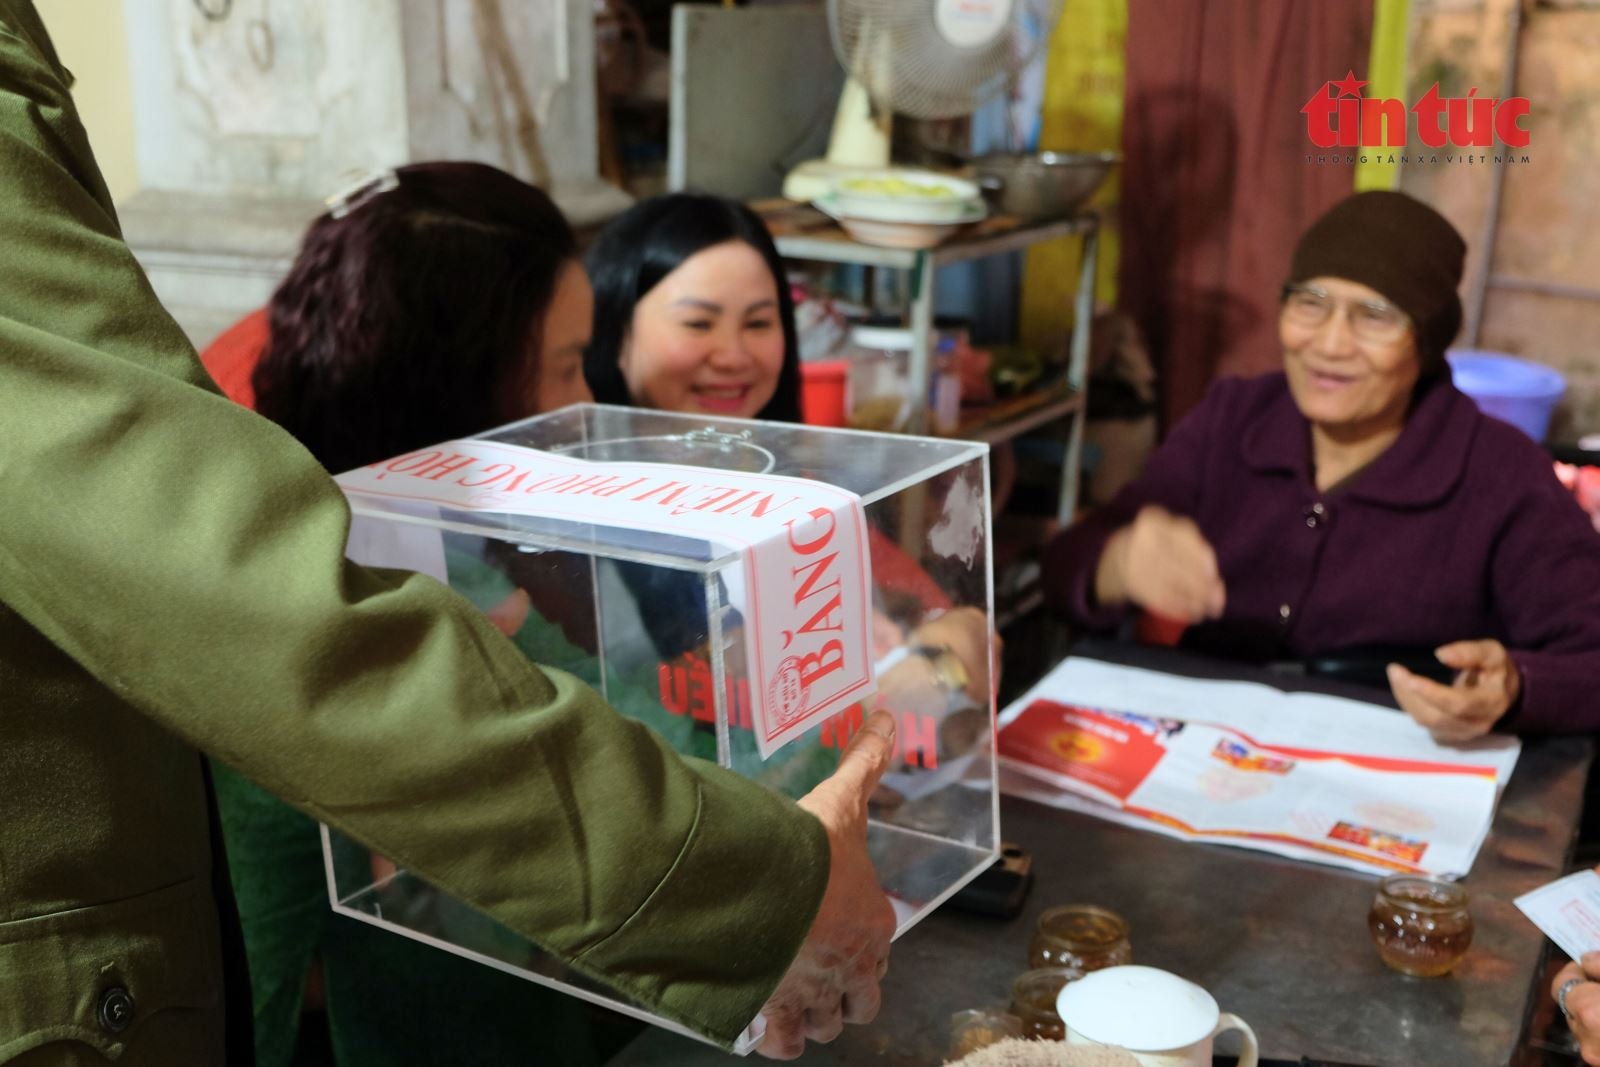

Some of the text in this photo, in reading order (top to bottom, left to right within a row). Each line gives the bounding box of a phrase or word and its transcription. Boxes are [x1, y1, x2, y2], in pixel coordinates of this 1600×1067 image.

[367, 450, 845, 690] BĂNG NIÊM PHONG HÒ
